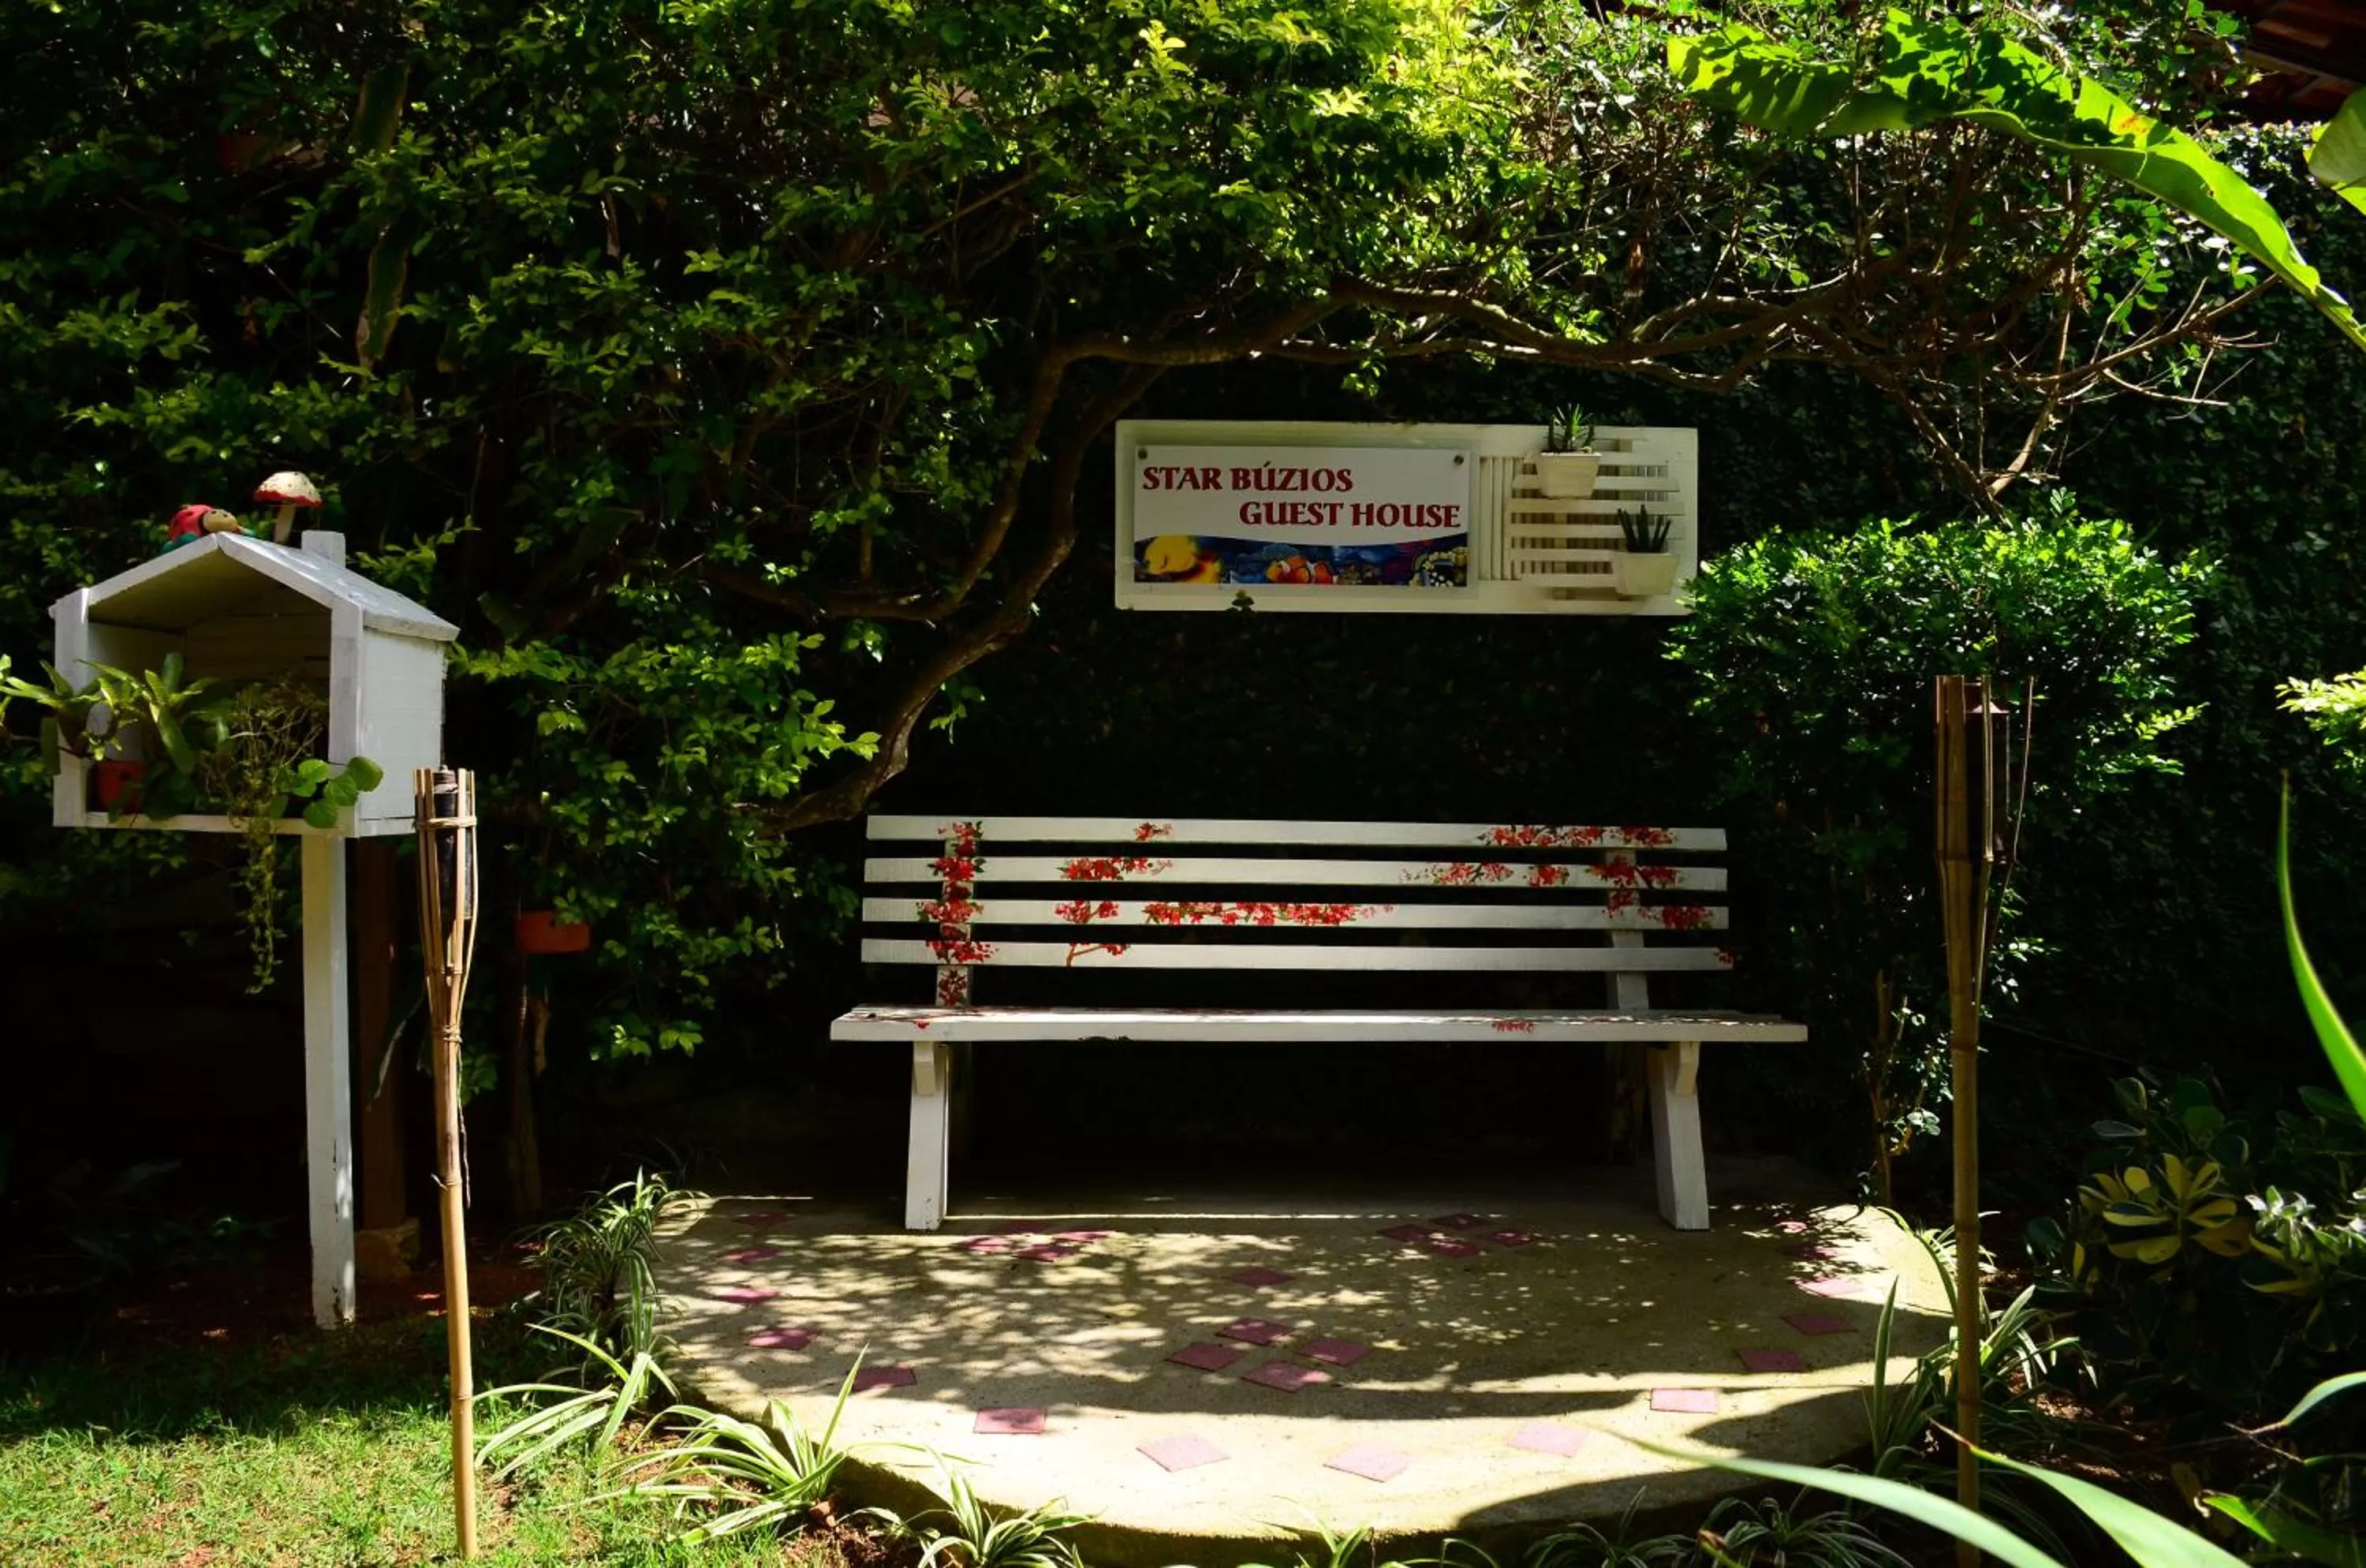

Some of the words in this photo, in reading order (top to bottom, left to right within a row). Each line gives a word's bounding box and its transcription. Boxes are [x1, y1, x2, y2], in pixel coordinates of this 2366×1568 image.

[1143, 466, 1223, 491] STAR
[1230, 461, 1353, 491] BÚZIOS
[1239, 502, 1344, 526] GUEST
[1351, 503, 1461, 528] HOUSE
